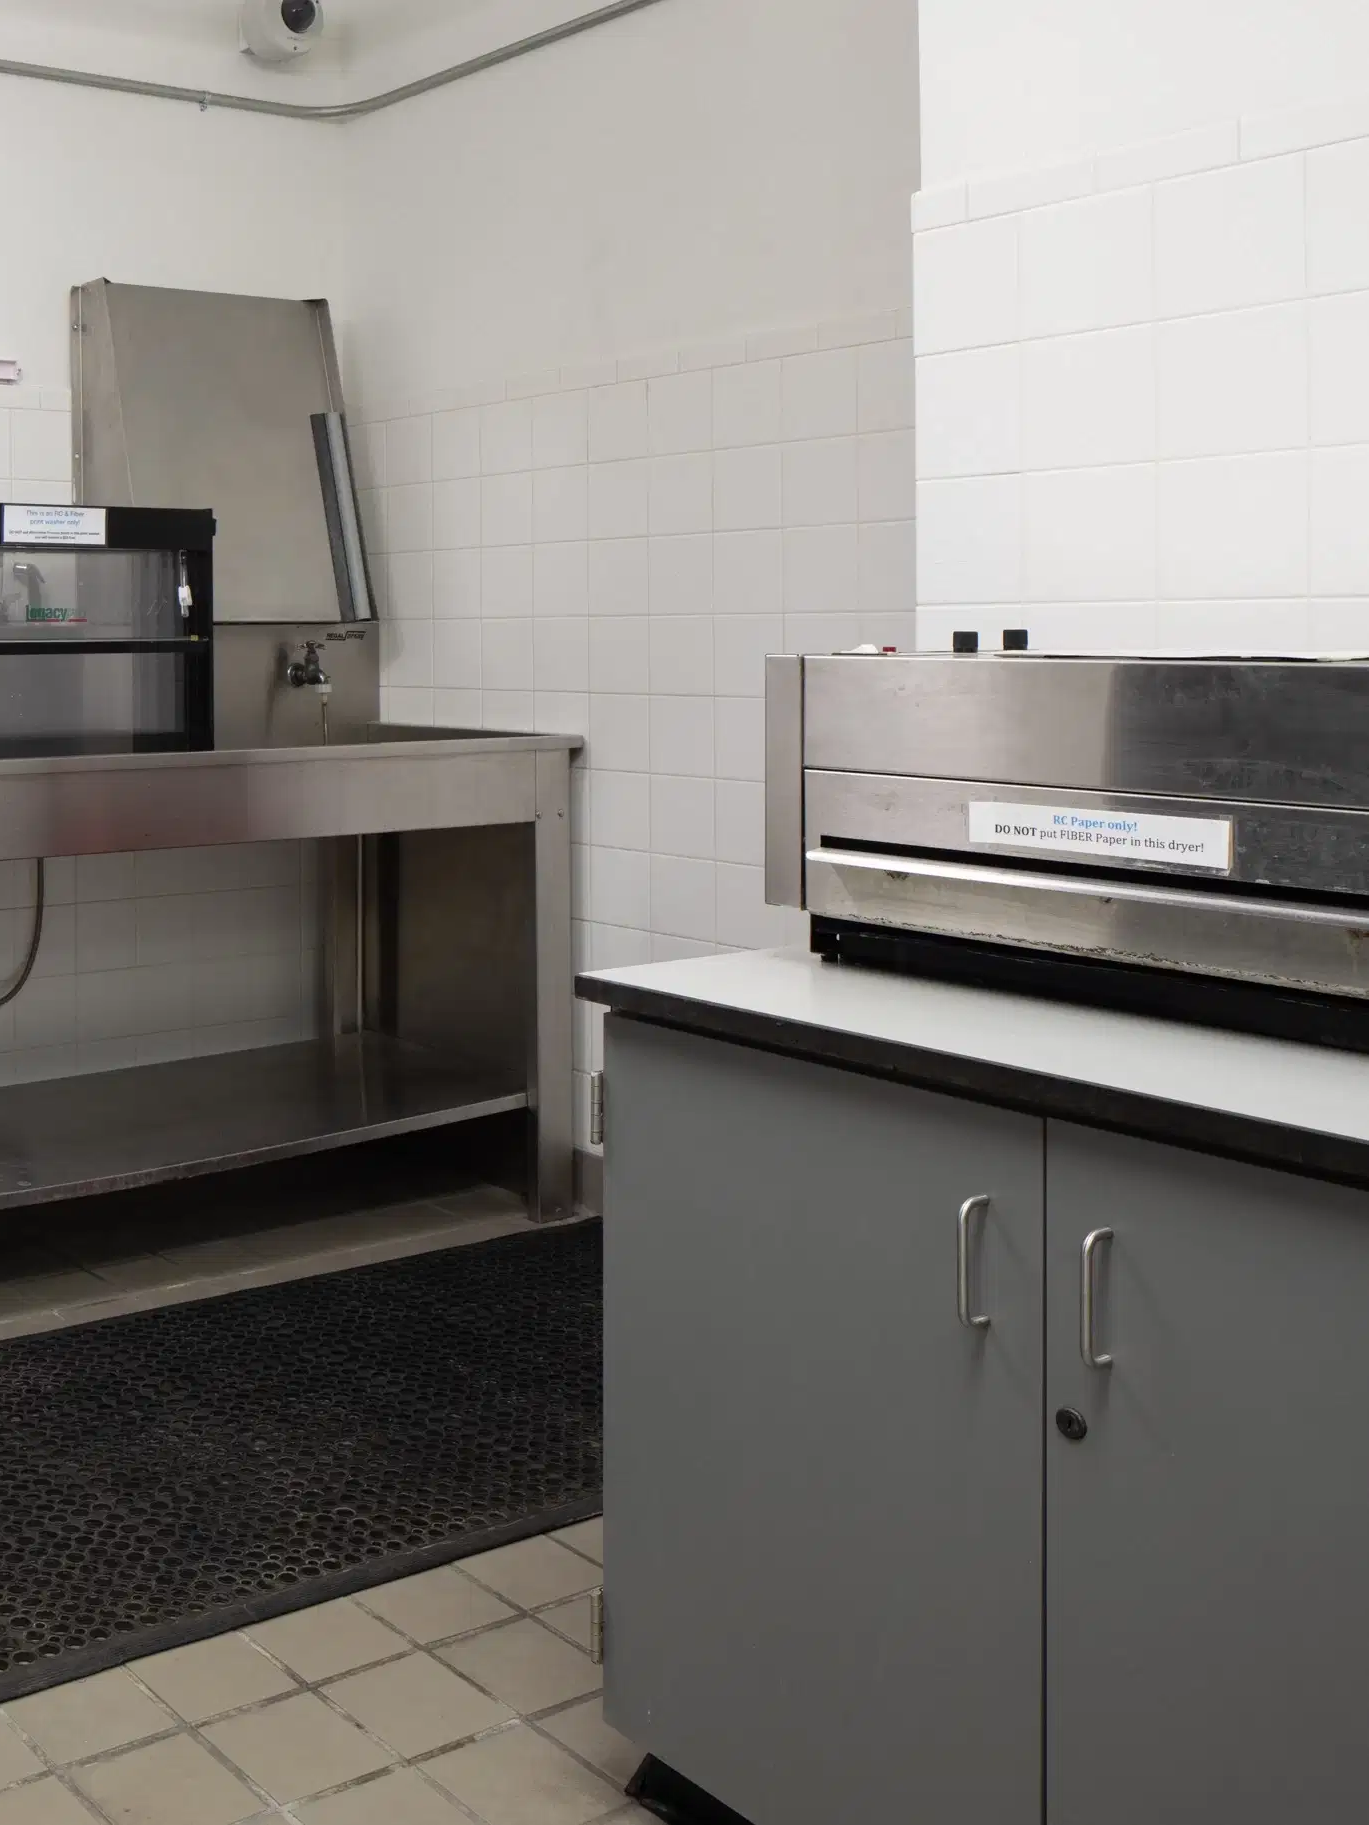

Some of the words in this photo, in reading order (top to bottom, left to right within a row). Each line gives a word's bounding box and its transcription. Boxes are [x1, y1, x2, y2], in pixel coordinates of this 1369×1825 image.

[1052, 814, 1068, 826] RC
[1071, 816, 1105, 831] Paper
[1107, 820, 1138, 832] only!
[994, 824, 1011, 835] DO
[1013, 826, 1038, 837] NOT
[1039, 829, 1058, 840] put
[1060, 829, 1093, 843] FIBER
[1095, 833, 1128, 846] Paper
[1130, 836, 1141, 847] in
[1143, 837, 1166, 850] this
[1168, 840, 1205, 853] dryer!
